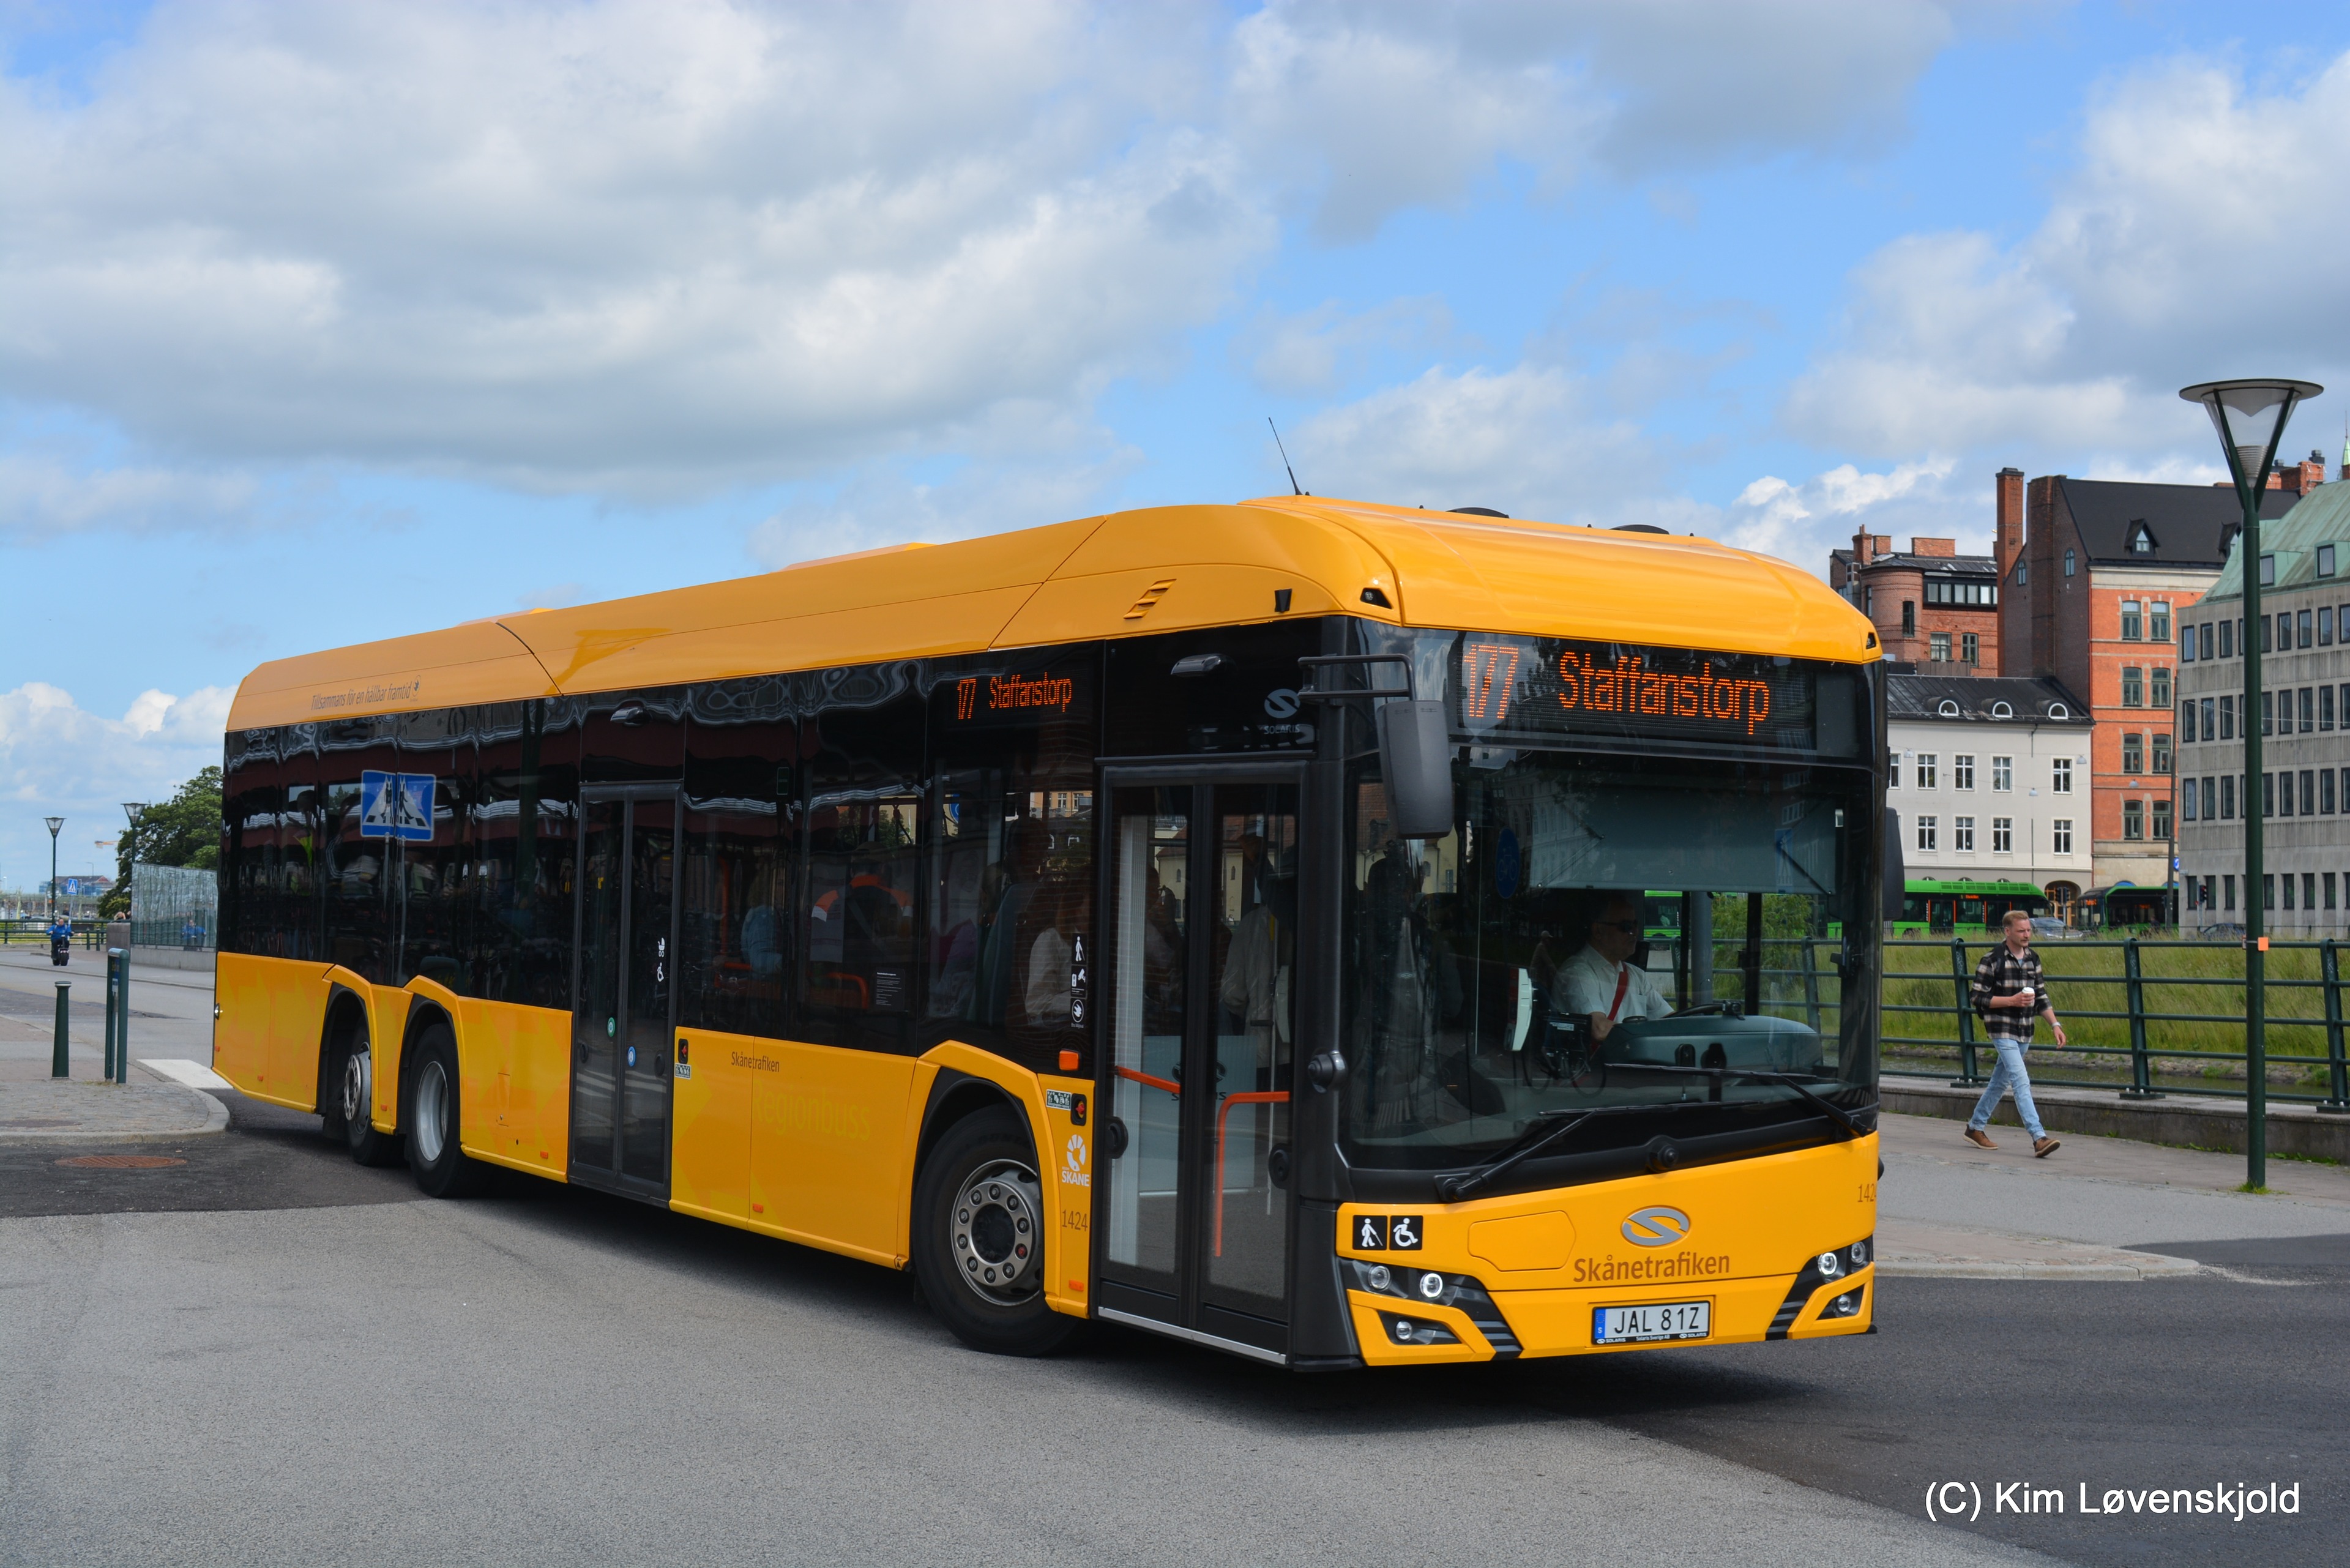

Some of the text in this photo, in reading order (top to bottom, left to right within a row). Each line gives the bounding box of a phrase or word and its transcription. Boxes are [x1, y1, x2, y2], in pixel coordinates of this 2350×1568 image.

[311, 681, 412, 710] Tillsammans för en hållbar framtid
[957, 671, 1072, 719] 177 Staffanstorp
[1464, 644, 1770, 734] 177 Staffanstorp
[1263, 724, 1300, 734] SOLARIS
[731, 1051, 780, 1072] Skånetrafiken
[752, 1078, 871, 1141] Regionbuss
[1062, 1209, 1088, 1232] 1424
[1573, 1252, 1729, 1282] Skånetrafiken
[1614, 1307, 1699, 1334] JAL 81Z
